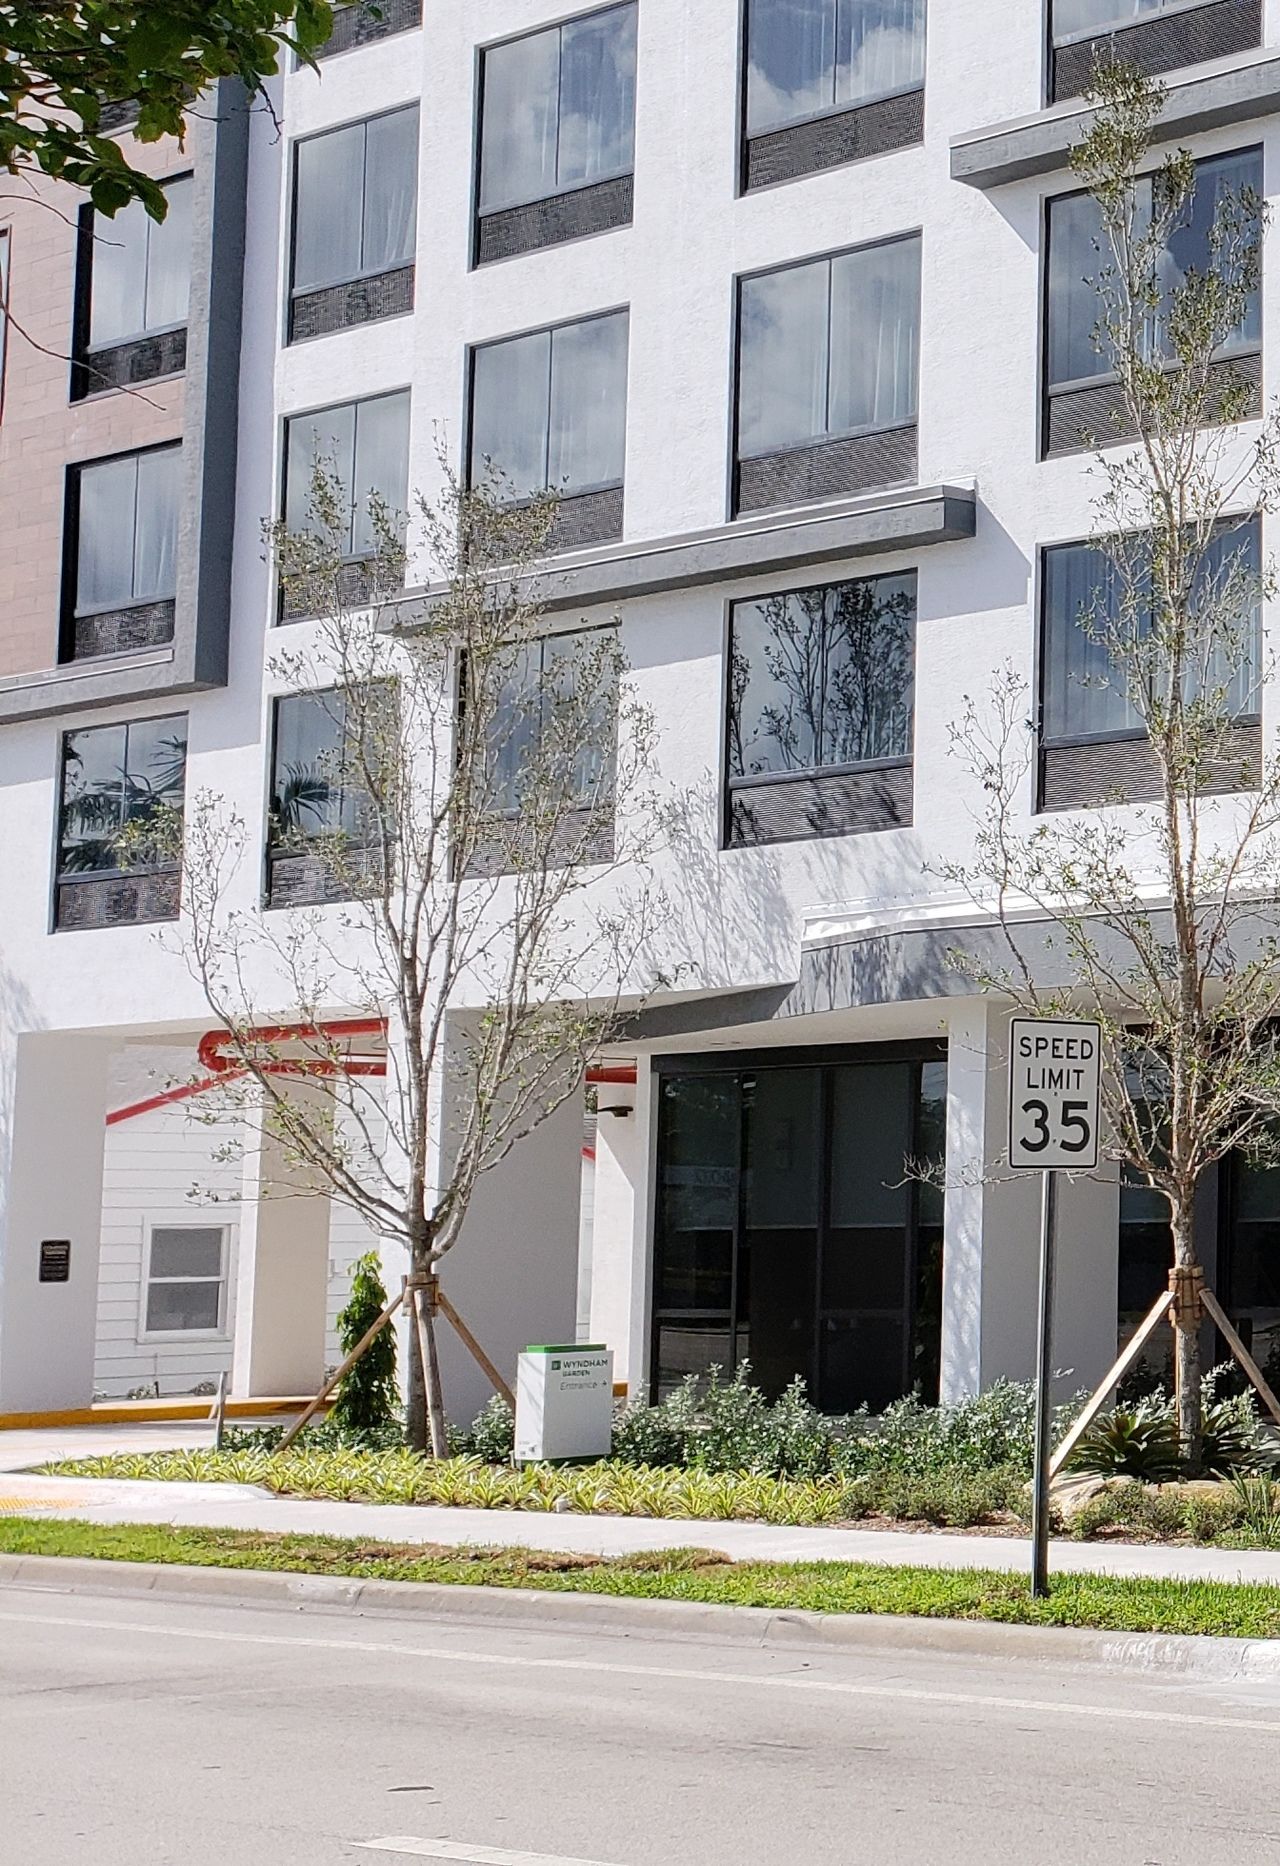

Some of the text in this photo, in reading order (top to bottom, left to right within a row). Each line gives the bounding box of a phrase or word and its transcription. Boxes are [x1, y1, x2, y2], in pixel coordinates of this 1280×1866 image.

[1019, 1036, 1094, 1060] SPEED
[1027, 1067, 1085, 1090] LIMIT
[1019, 1099, 1091, 1152] 35
[563, 1359, 608, 1369] WYNDHAM
